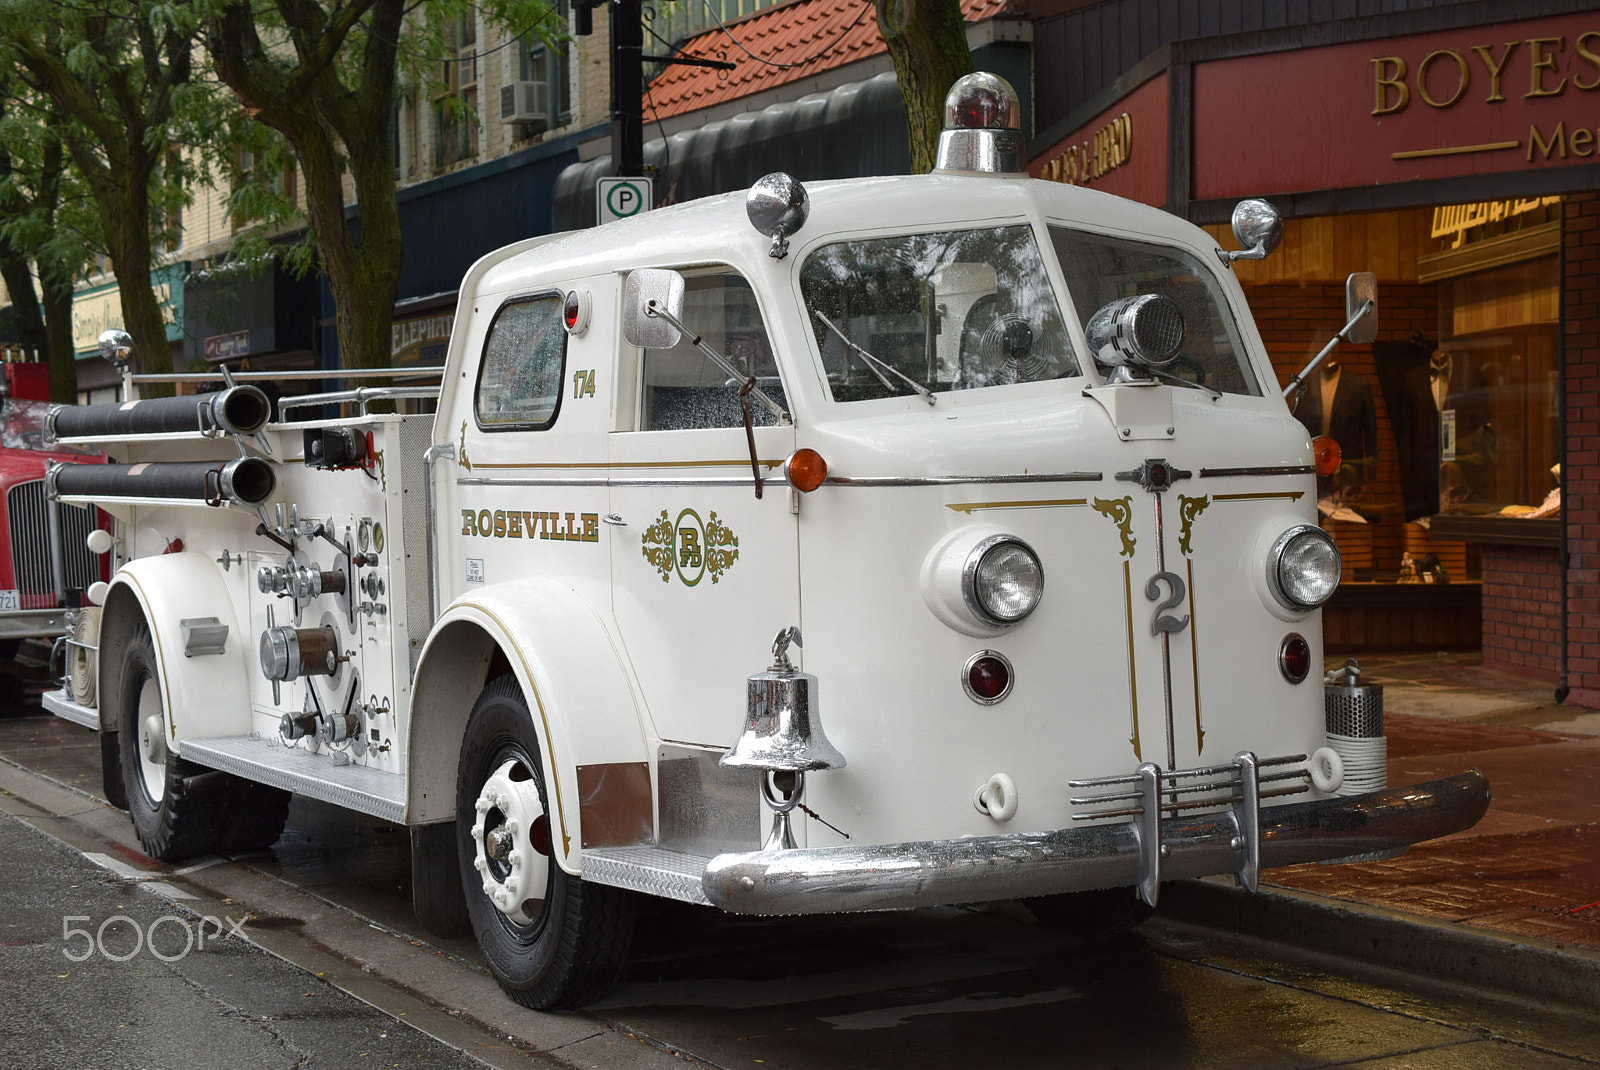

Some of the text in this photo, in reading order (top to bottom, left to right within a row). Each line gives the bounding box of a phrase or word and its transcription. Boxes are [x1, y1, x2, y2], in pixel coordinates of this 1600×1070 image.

[1371, 31, 1600, 116] BOYES
[1093, 113, 1132, 179] HERD
[1526, 121, 1600, 162] Me
[620, 191, 633, 210] P
[573, 369, 595, 399] 174
[461, 509, 599, 542] ROSEVILLE
[1145, 571, 1190, 636] 2
